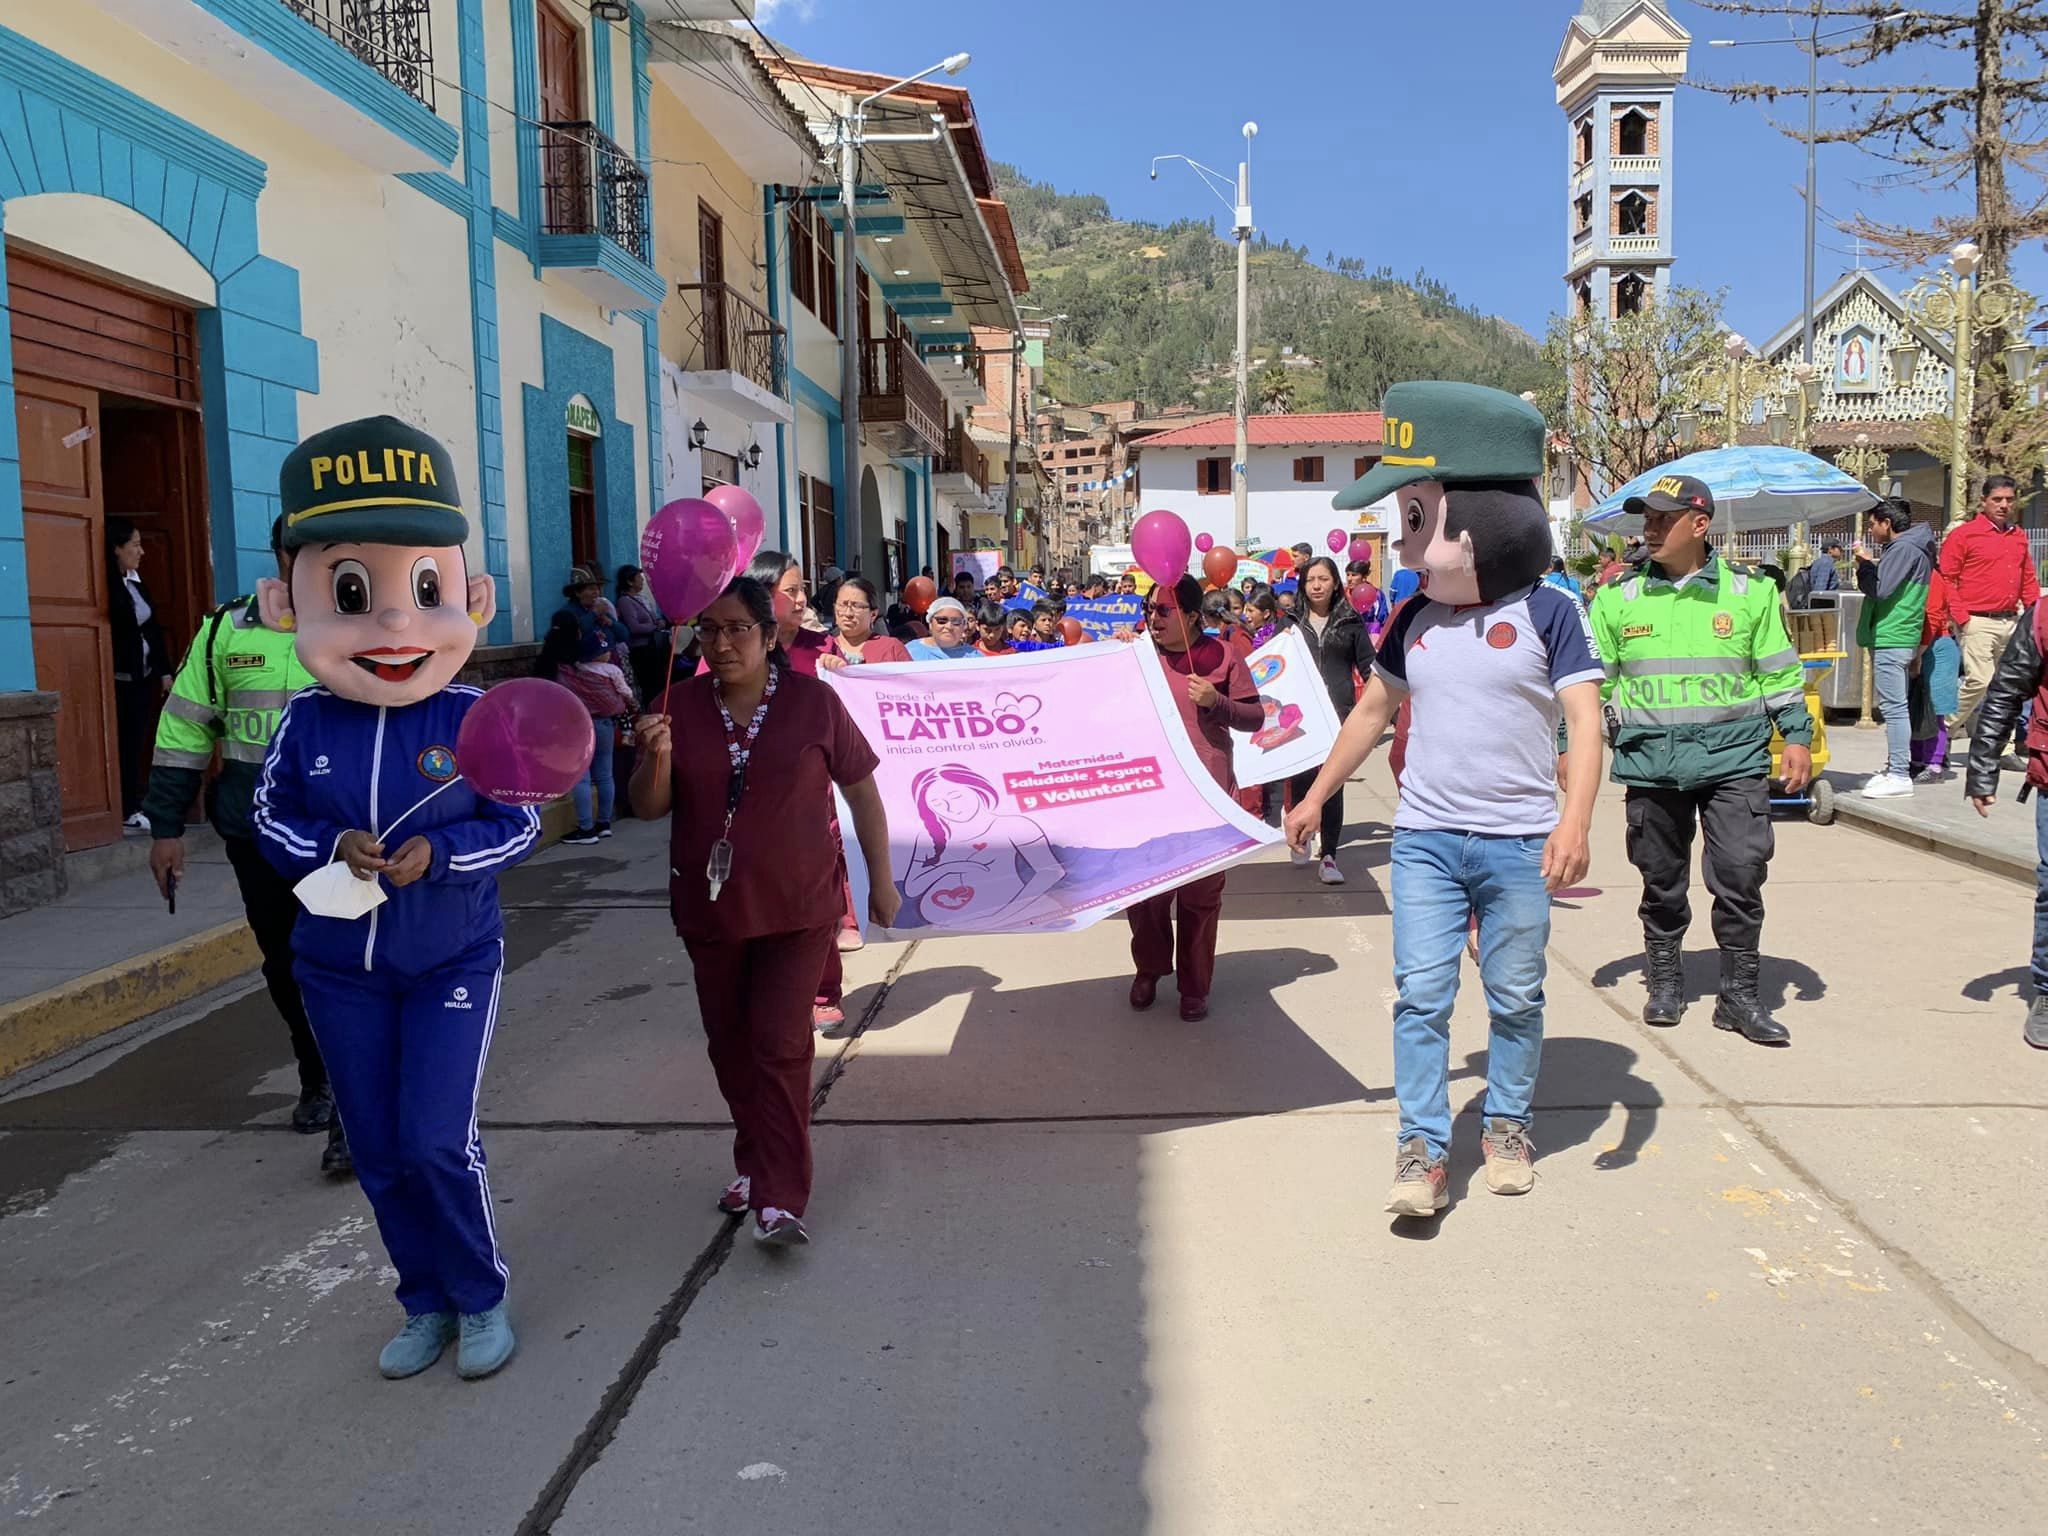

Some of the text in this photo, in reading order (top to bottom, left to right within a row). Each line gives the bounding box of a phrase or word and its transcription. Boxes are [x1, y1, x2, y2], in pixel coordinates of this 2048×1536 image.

[311, 448, 437, 490] POLITA
[875, 691, 935, 701] Desde el
[878, 701, 985, 718] PRIMER
[881, 714, 1040, 740] LATIDO,
[886, 736, 1047, 755] inicia control sin olvido.
[1038, 752, 1125, 770] Maternidad
[1096, 765, 1154, 779] Segura
[1024, 796, 1038, 809] y
